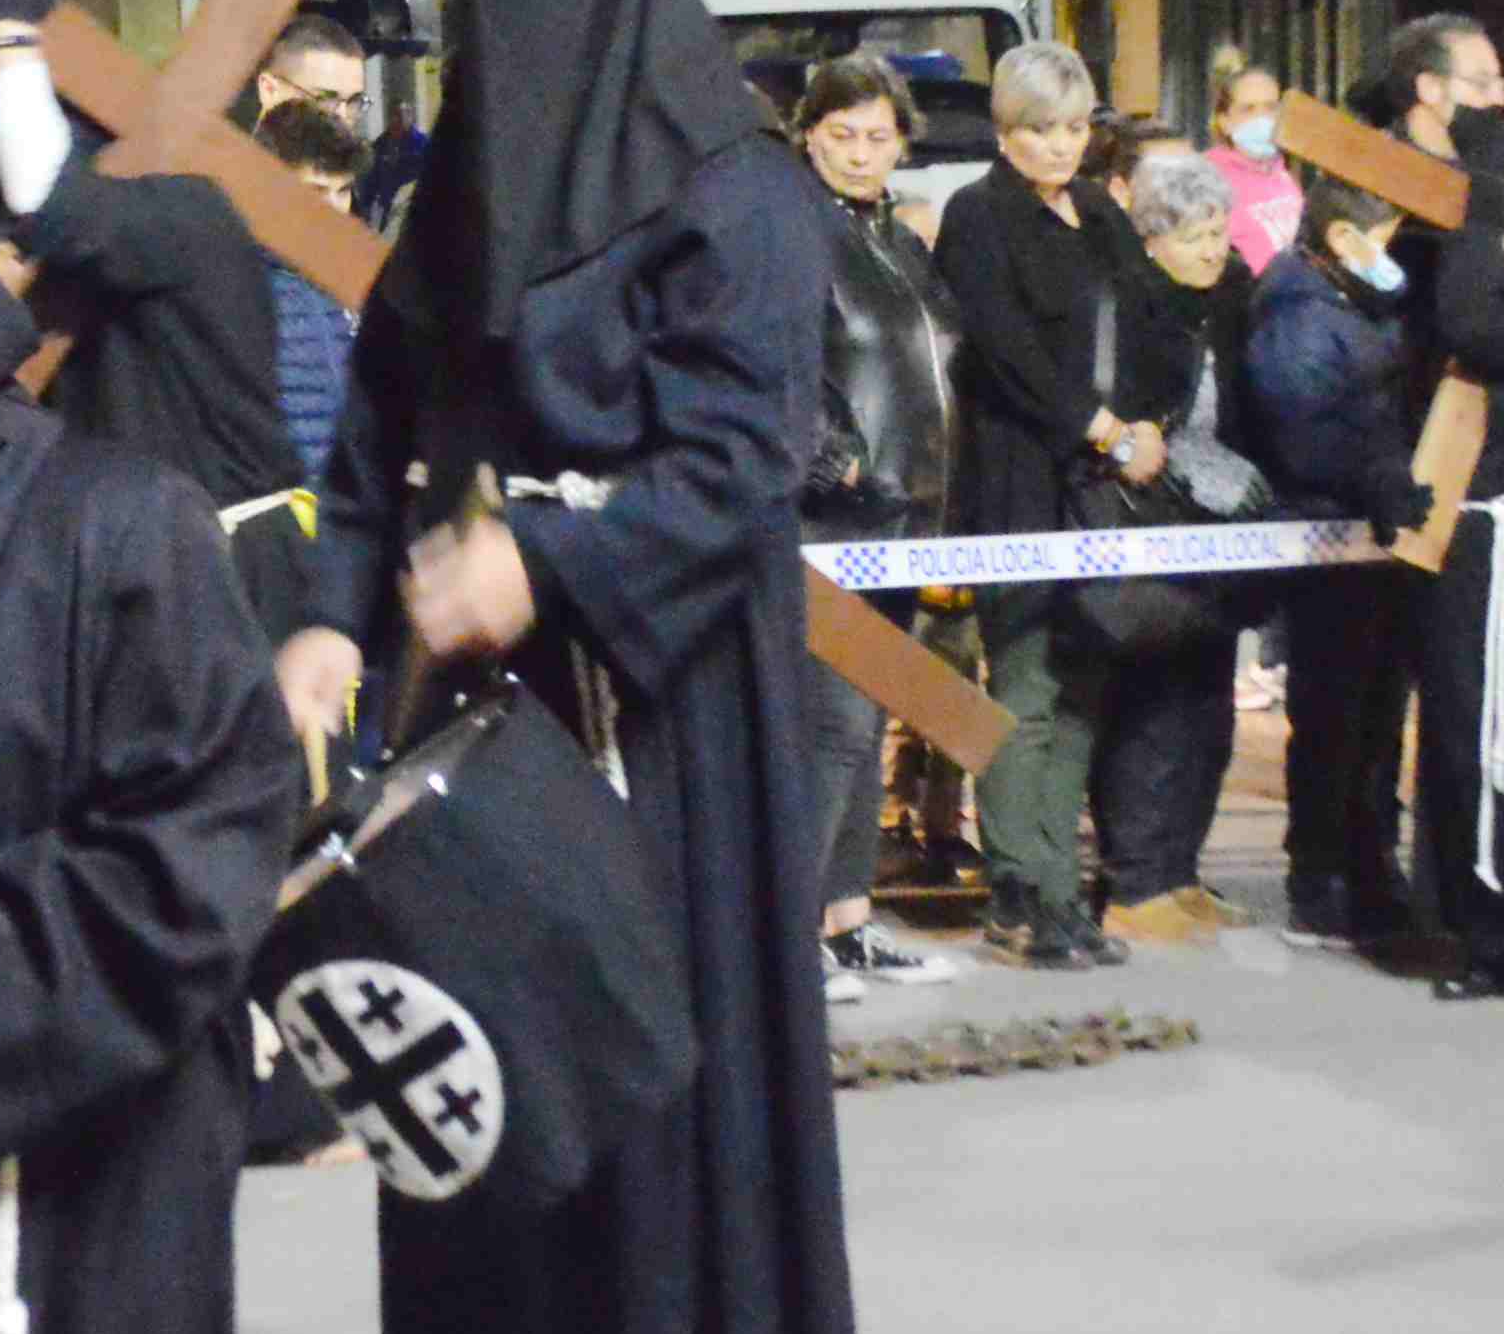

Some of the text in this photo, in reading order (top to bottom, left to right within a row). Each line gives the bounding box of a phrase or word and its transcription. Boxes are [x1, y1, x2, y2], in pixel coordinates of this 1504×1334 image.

[907, 541, 1058, 580] POLICIA LOCAL
[1143, 530, 1285, 566] POLICIA LOCAL
